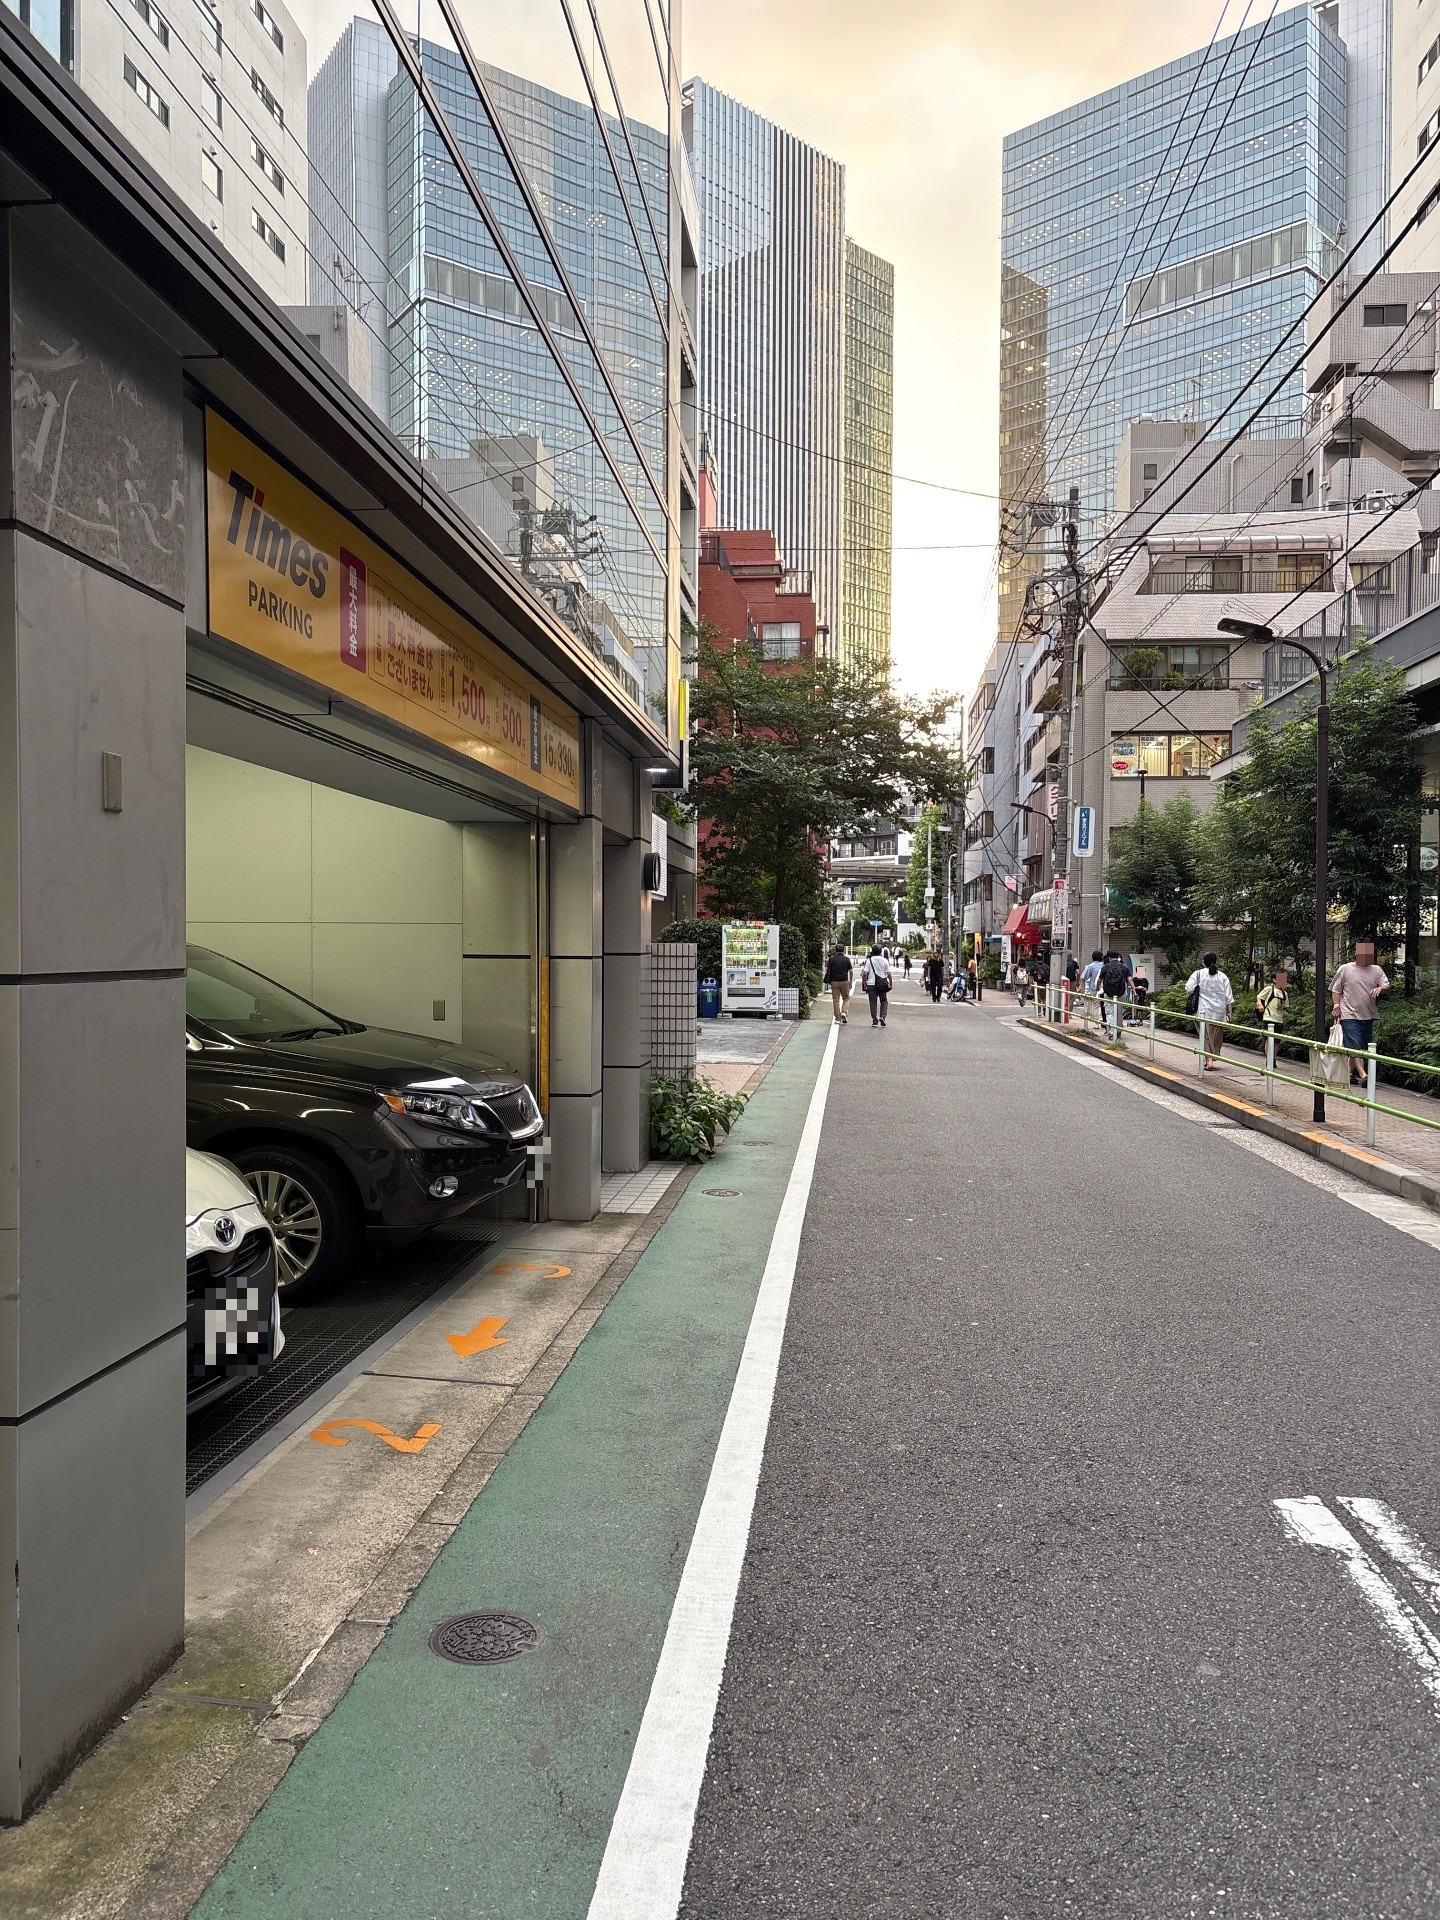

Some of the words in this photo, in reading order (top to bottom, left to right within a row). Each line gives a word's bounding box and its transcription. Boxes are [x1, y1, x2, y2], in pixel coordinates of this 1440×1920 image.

[226, 469, 329, 600] Times
[247, 579, 314, 640] PARKING
[348, 564, 358, 659] 最大料金
[387, 619, 434, 672] 最大料金は
[387, 652, 434, 702] ございません
[491, 1263, 572, 1280] 3
[309, 1417, 443, 1454] 2
